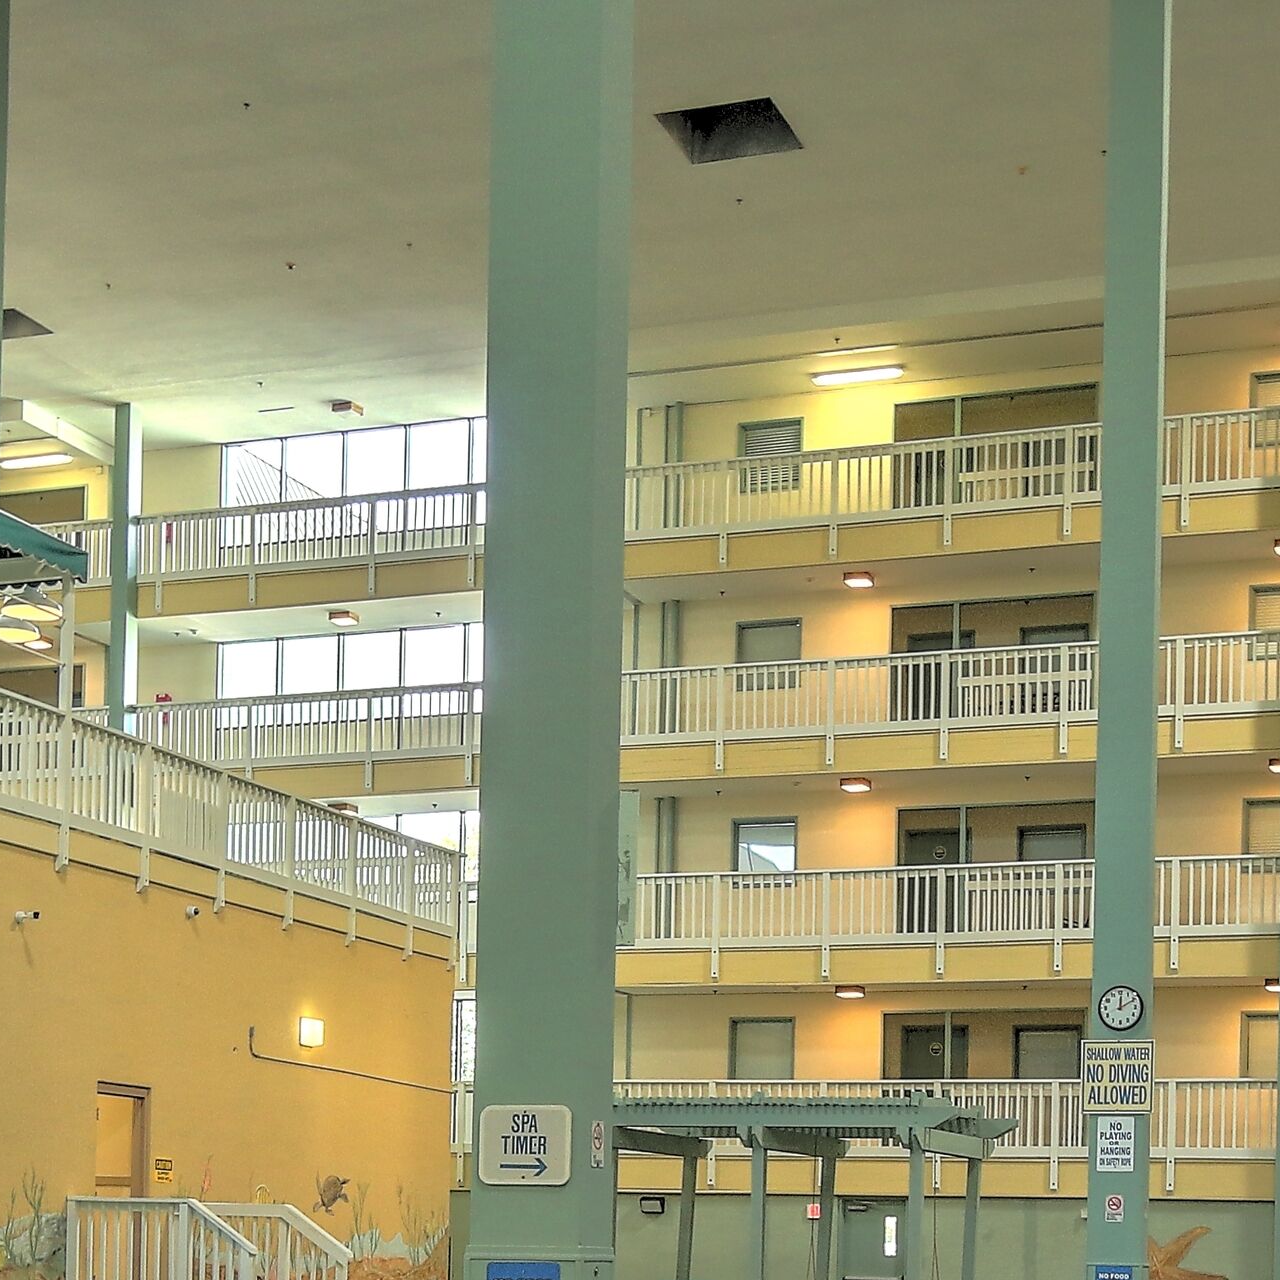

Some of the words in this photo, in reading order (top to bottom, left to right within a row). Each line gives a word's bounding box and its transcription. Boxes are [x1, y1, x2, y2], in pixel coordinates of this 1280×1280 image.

[1087, 1047, 1122, 1061] SHALLOW
[1124, 1047, 1150, 1061] WATER
[1087, 1064, 1104, 1083] NO
[1109, 1064, 1149, 1083] DIVING
[1088, 1085, 1147, 1105] ALLOWED
[511, 1113, 538, 1133] SPA
[1110, 1122, 1122, 1131] NO
[1100, 1131, 1132, 1141] PLAYING
[501, 1135, 547, 1155] TIMER
[1100, 1146, 1131, 1156] HANGING
[1098, 1272, 1109, 1280] NO
